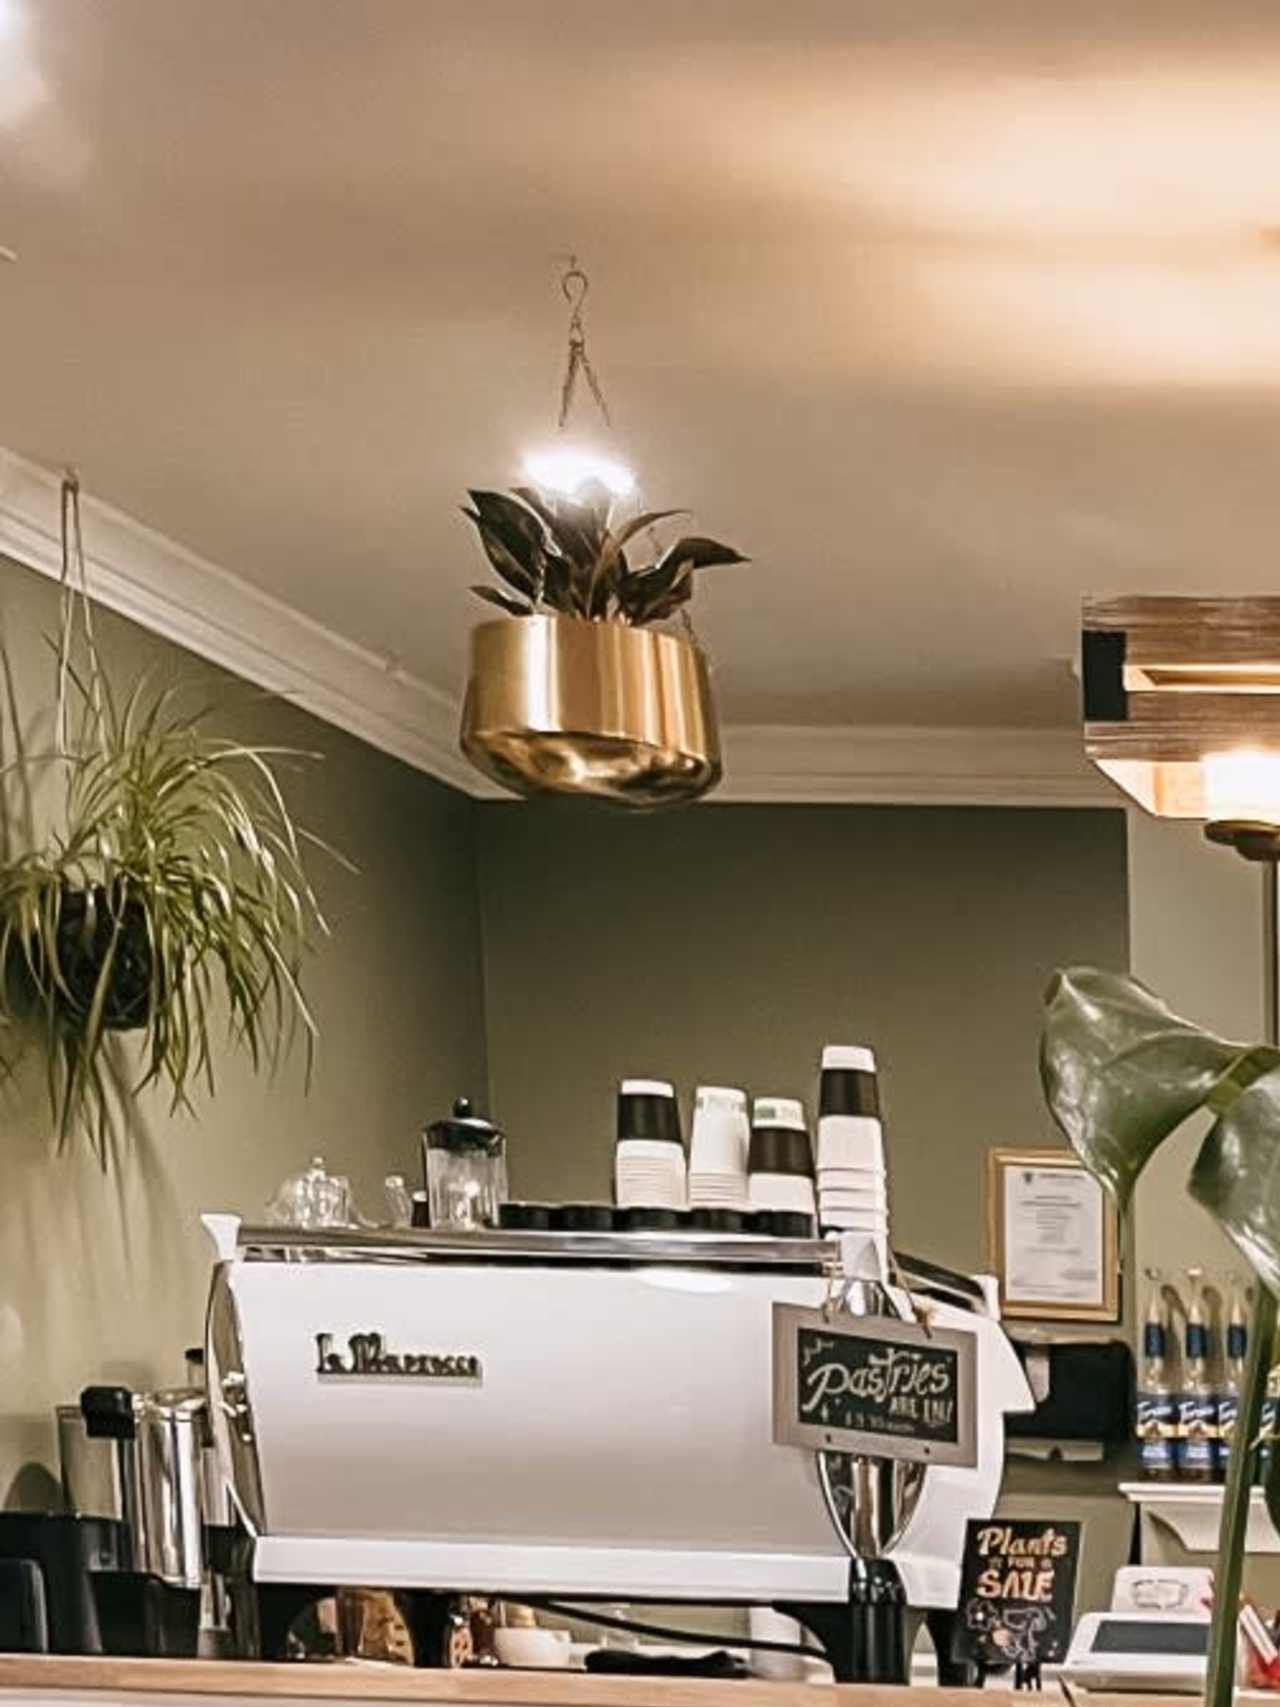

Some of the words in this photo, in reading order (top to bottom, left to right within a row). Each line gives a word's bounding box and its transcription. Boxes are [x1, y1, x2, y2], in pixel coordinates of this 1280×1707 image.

[802, 1348, 950, 1411] Pastries
[976, 1526, 1067, 1557] Plants
[1007, 1555, 1035, 1569] FOR
[976, 1568, 1056, 1601] SALE
